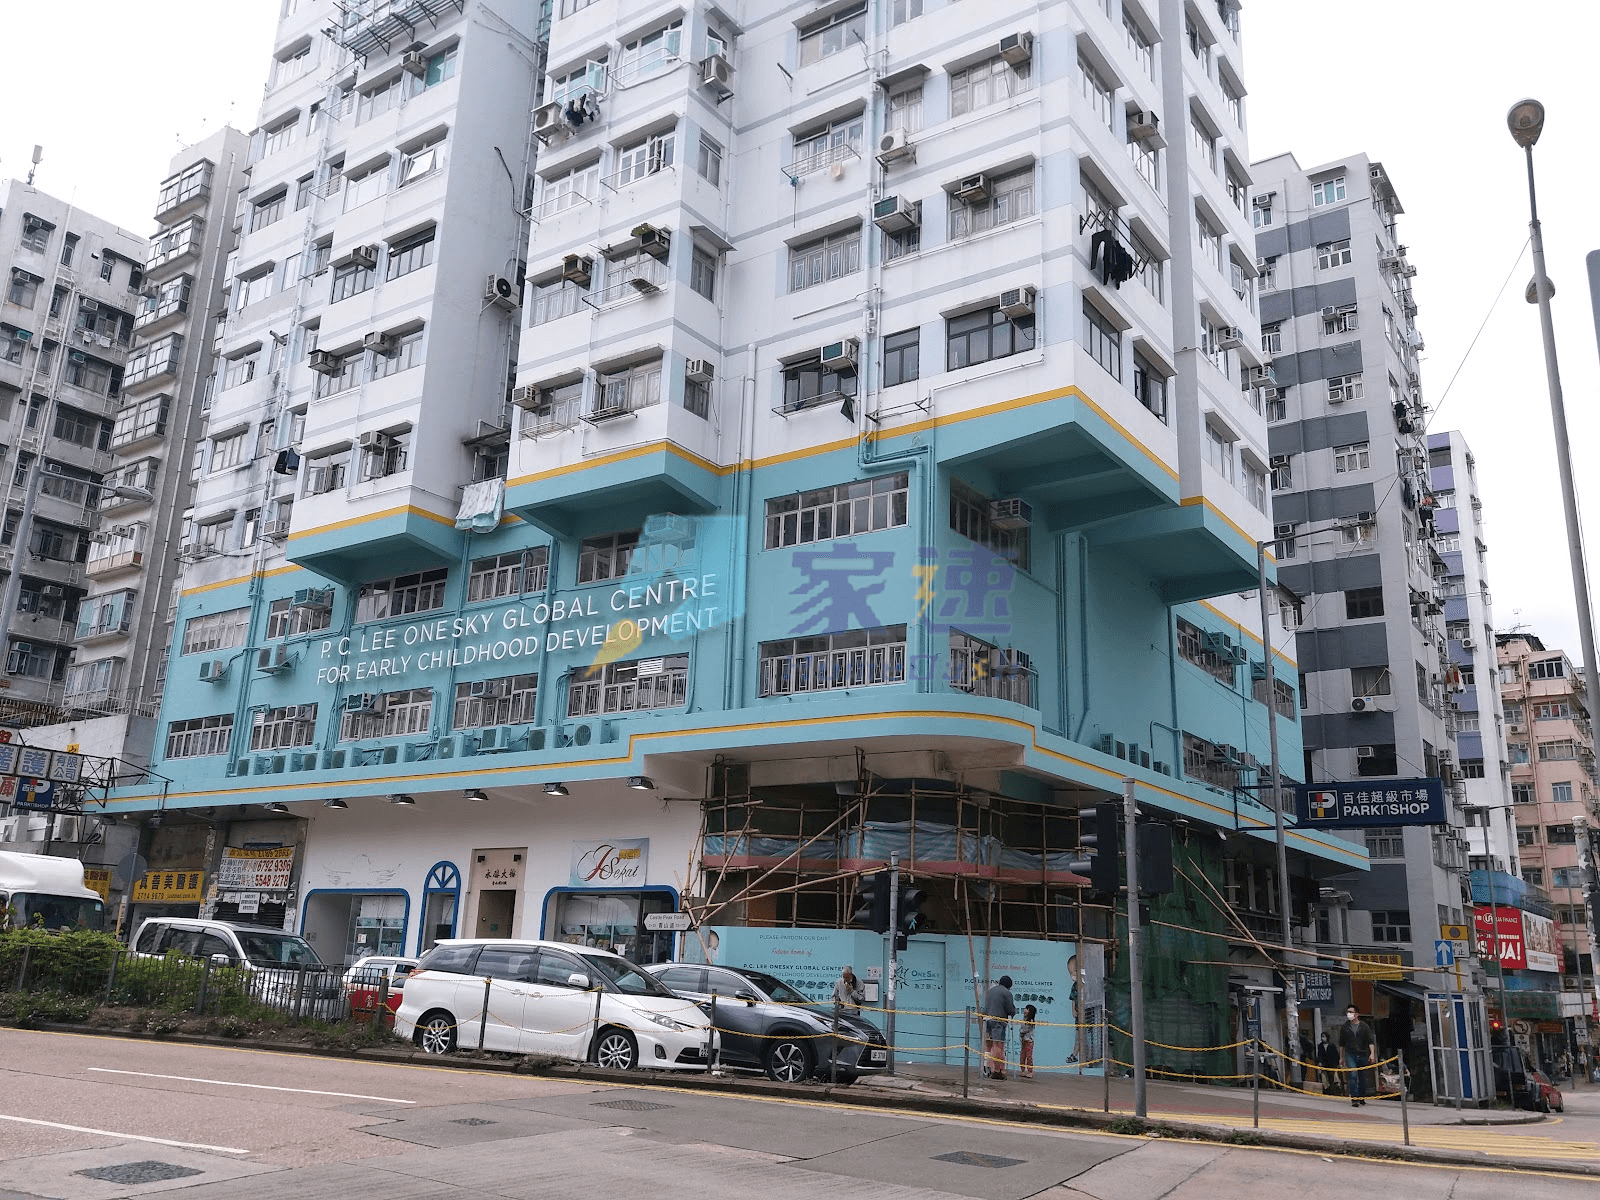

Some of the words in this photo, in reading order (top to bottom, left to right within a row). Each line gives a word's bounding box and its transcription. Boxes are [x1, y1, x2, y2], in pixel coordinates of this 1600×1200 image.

[316, 666, 350, 686] FOR
[356, 654, 412, 680] EARLY
[417, 636, 538, 671] CHILDHOOD
[546, 606, 718, 653] DEVELOPMENT
[360, 629, 396, 653] LEE
[502, 595, 599, 630] GLOBAL
[610, 573, 716, 612] CENTRE
[1342, 788, 1429, 805] 百佳超級市場
